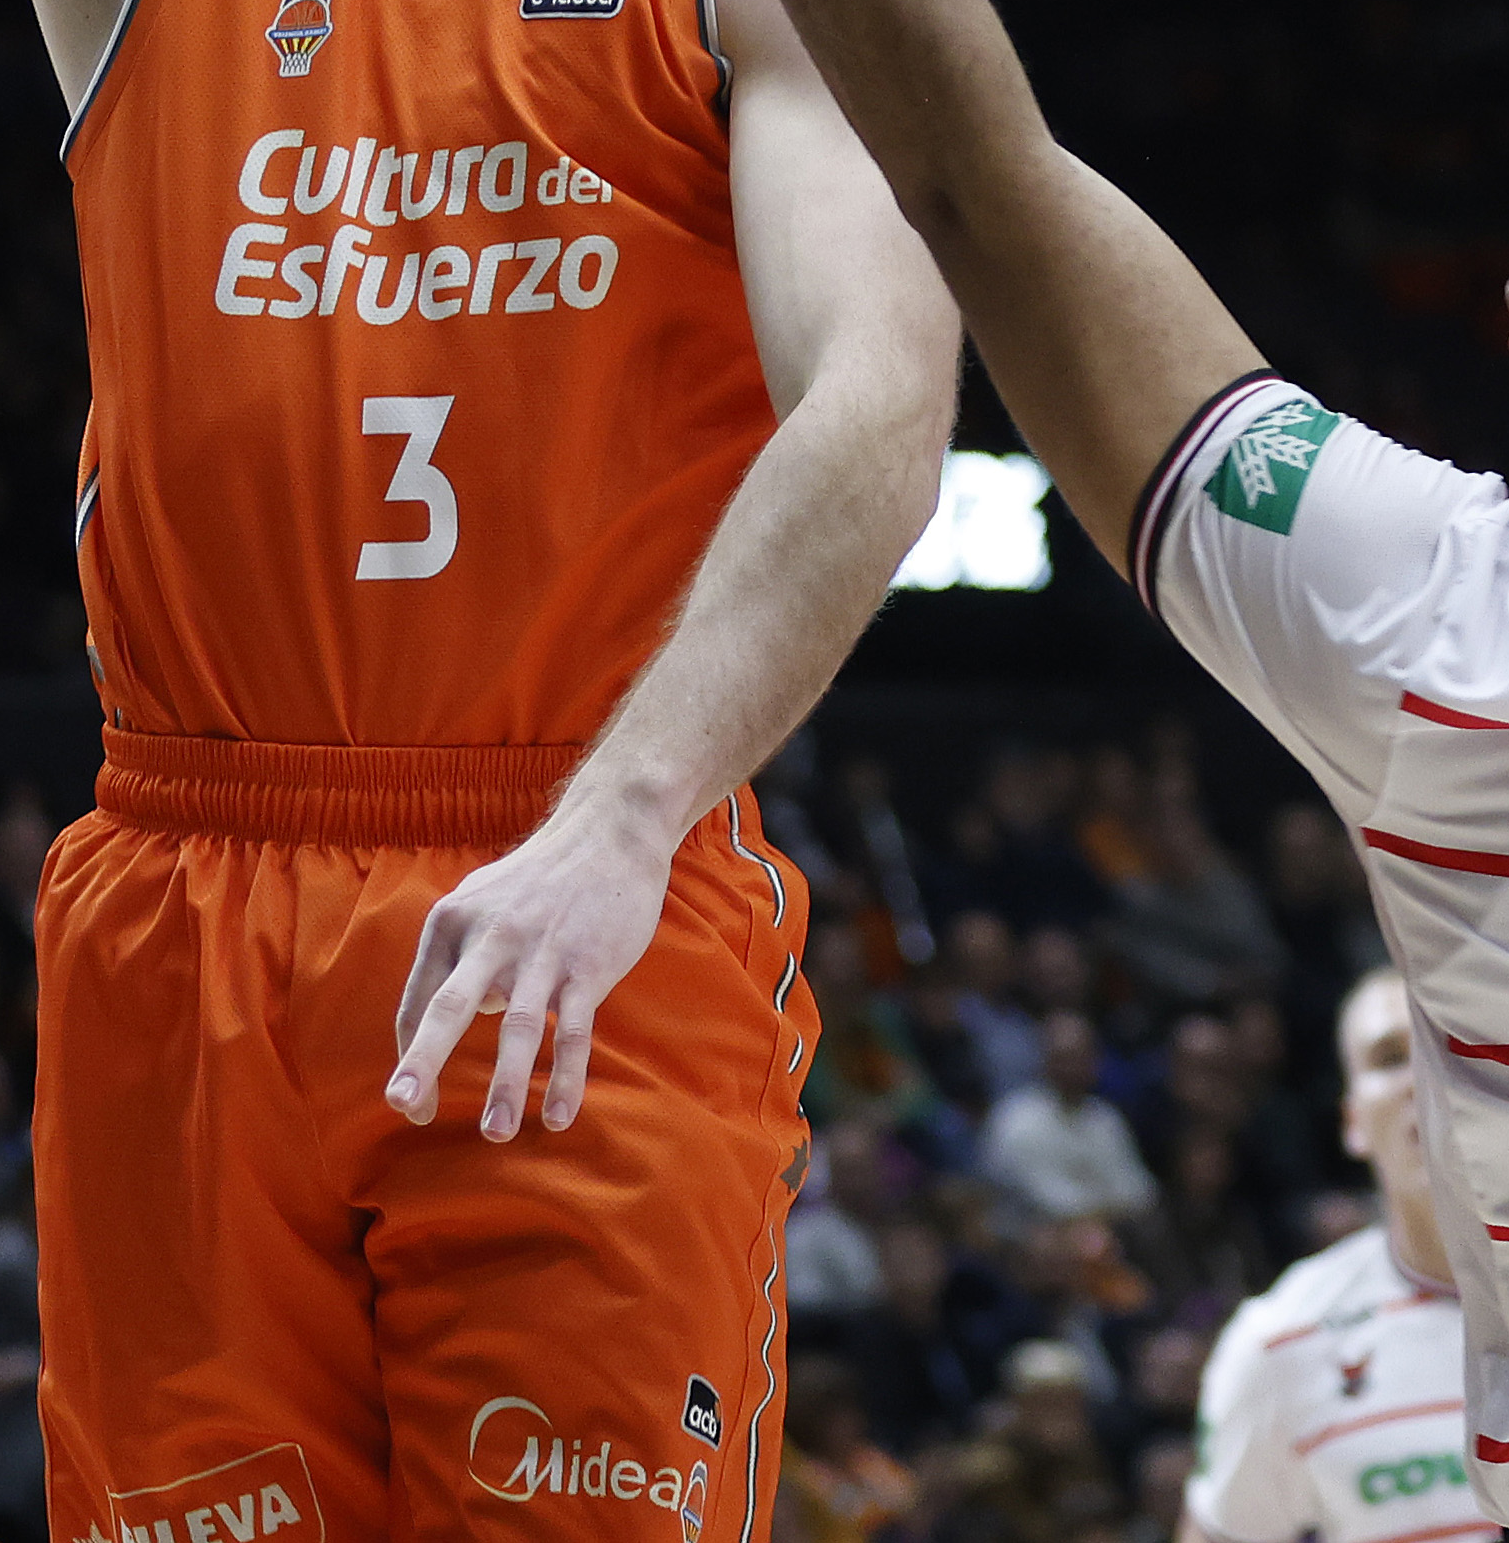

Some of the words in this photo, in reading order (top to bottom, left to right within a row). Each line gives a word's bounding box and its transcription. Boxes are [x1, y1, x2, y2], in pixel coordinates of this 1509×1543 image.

[237, 129, 528, 227] Cultura
[536, 154, 613, 207] del
[215, 222, 619, 325] Esfuerzo
[355, 395, 458, 581] 3
[689, 1403, 718, 1438] acb
[501, 1436, 684, 1512] Midea
